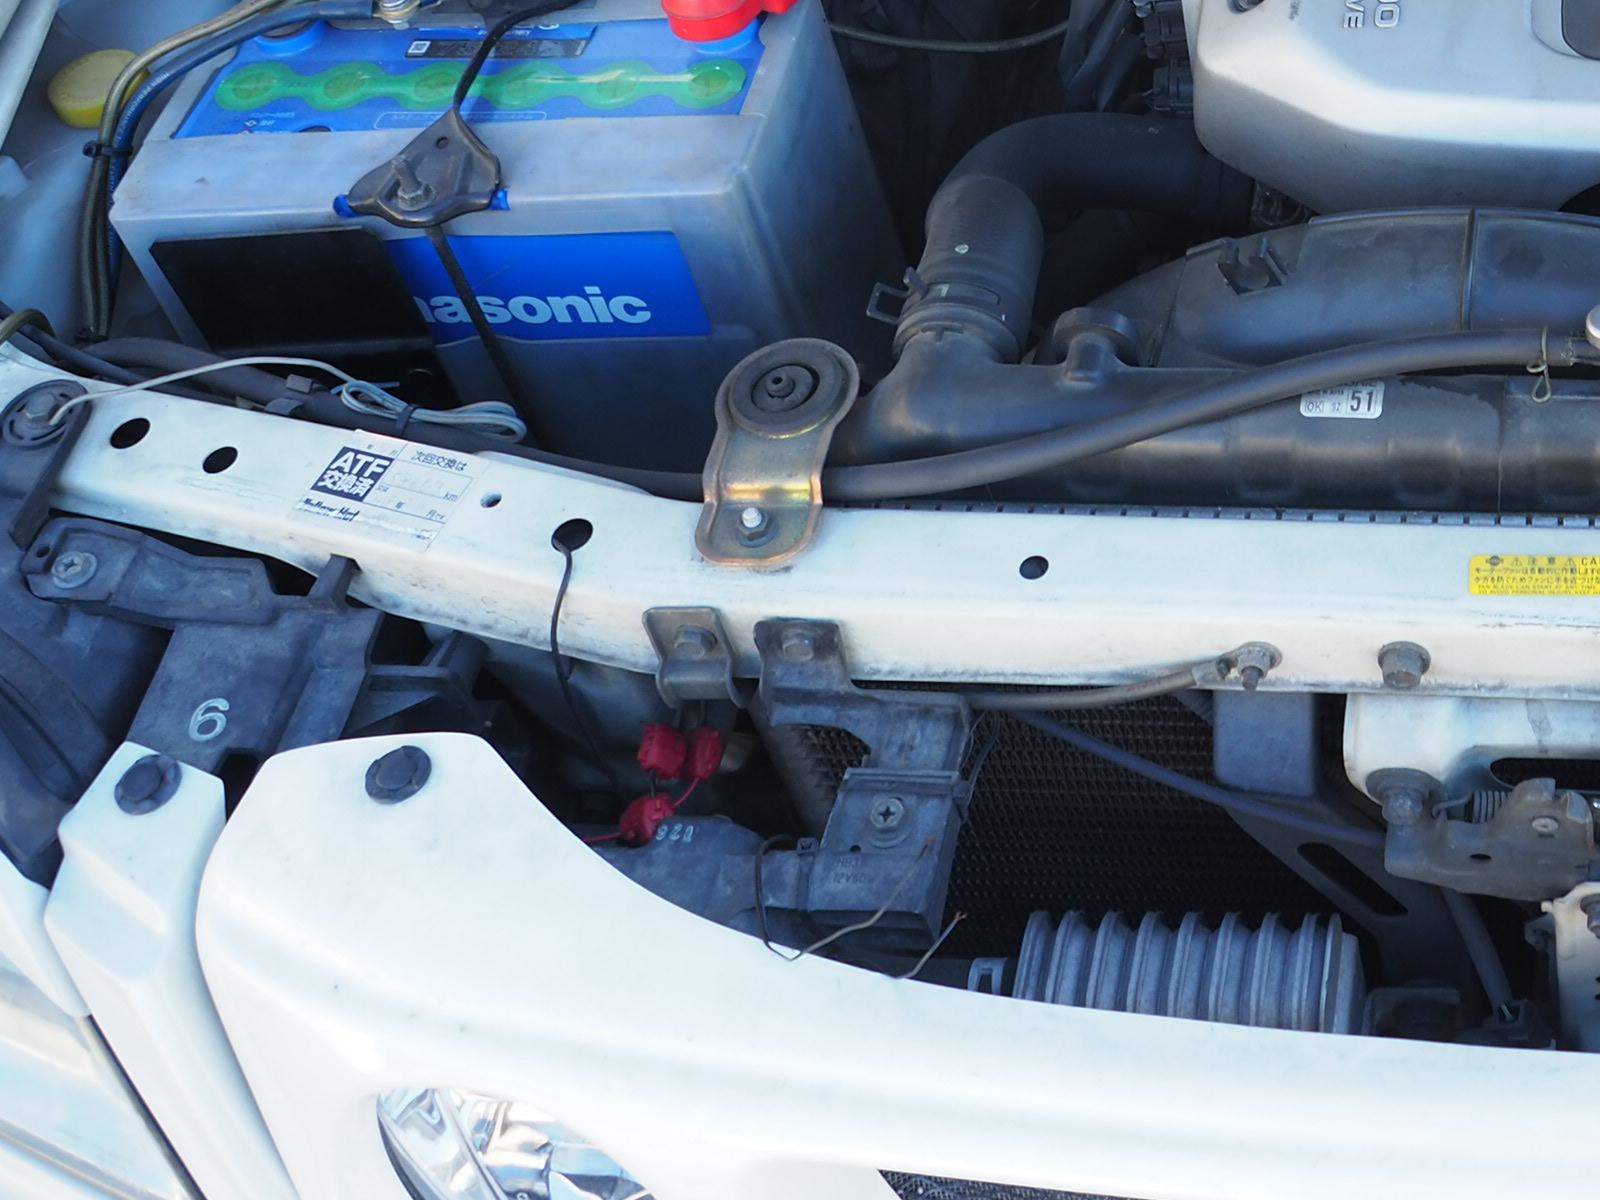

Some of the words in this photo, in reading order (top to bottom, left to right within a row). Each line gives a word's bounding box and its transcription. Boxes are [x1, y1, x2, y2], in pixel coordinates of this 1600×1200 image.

[1306, 402, 1324, 412] OK
[1350, 390, 1374, 412] 51
[329, 451, 391, 478] ATF
[411, 450, 468, 472] 次回交換は
[317, 469, 375, 498] 交換済
[442, 492, 459, 502] km
[188, 697, 230, 742] 6
